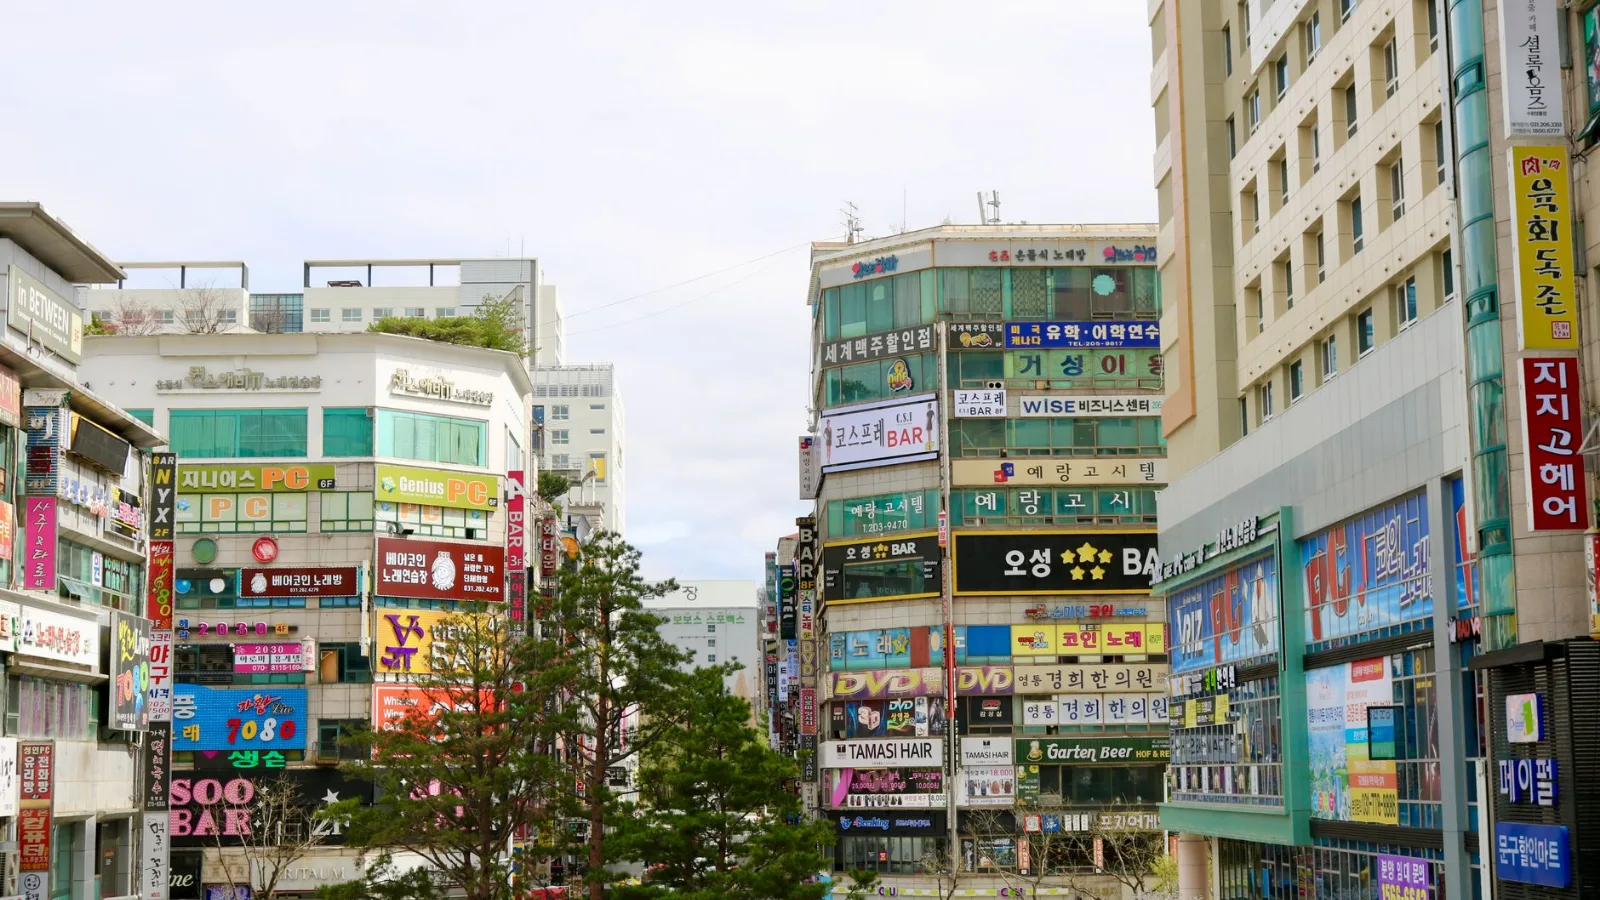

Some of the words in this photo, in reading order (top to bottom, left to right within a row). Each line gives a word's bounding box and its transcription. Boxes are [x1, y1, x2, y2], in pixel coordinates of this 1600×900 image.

[29, 286, 69, 336] BETWEEN
[825, 326, 931, 363] 세계맥주할인점
[957, 391, 1004, 406] 코스프레
[1078, 399, 1150, 413] 비즈니스센터
[970, 406, 992, 416] BAR
[835, 417, 885, 449] 코스프레
[887, 426, 924, 448] BAR
[1533, 361, 1577, 523] 지지고헤어
[152, 455, 175, 465] BAR
[181, 469, 256, 489] 지니어스
[261, 467, 310, 490] PC
[320, 479, 333, 488] 6F
[1026, 461, 1155, 483] 예랑고시텔
[154, 468, 172, 524] NYX
[400, 475, 445, 495] Genius
[447, 478, 488, 506] PC
[974, 489, 1158, 515] 예랑고시
[851, 502, 875, 519] 예랑
[883, 495, 923, 514] 고시텔
[154, 528, 170, 537] 2F
[508, 510, 523, 548] BAR
[385, 551, 426, 568] 베어코인
[510, 555, 523, 567] 3F
[800, 528, 814, 578] BAR
[846, 545, 871, 560] 오성
[891, 542, 917, 556] BAR
[1003, 548, 1051, 578] 오성
[34, 579, 45, 587] 4F
[271, 574, 311, 587] 베어코인
[313, 573, 343, 586] 노래방
[382, 568, 428, 585] 노래연습장
[800, 581, 815, 590] 8F
[1089, 604, 1114, 618] 코인
[197, 621, 268, 637] 2030
[276, 623, 288, 633] 4F
[1062, 631, 1097, 649] 코인
[1106, 631, 1142, 648] 노래
[255, 645, 284, 654] 2030
[852, 633, 893, 657] 노래
[150, 644, 169, 685] 야구
[834, 671, 921, 697] DVD
[958, 667, 1013, 694] DVD
[1018, 674, 1042, 688] 영통
[1045, 669, 1153, 690] 경희한의원
[888, 700, 914, 711] DVD
[1027, 705, 1055, 720] 영통
[1062, 698, 1169, 721] 경희한의원
[226, 717, 296, 745] 7080
[848, 742, 897, 760] TAMASI
[900, 742, 933, 759] HAIR
[965, 751, 991, 759] TAMASI
[1047, 742, 1097, 762] Garten
[1099, 746, 1133, 759] Beer
[1135, 750, 1152, 758] HOF
[1153, 750, 1159, 758] &
[23, 756, 35, 793] 유리방
[37, 756, 50, 793] 전화방
[170, 778, 255, 806] SOO
[169, 808, 252, 836] BAR
[22, 816, 47, 857] 컴퓨터
[1498, 834, 1561, 870] 문구할인마트
[1396, 861, 1411, 883] 임대
[1412, 863, 1425, 886] 문의
